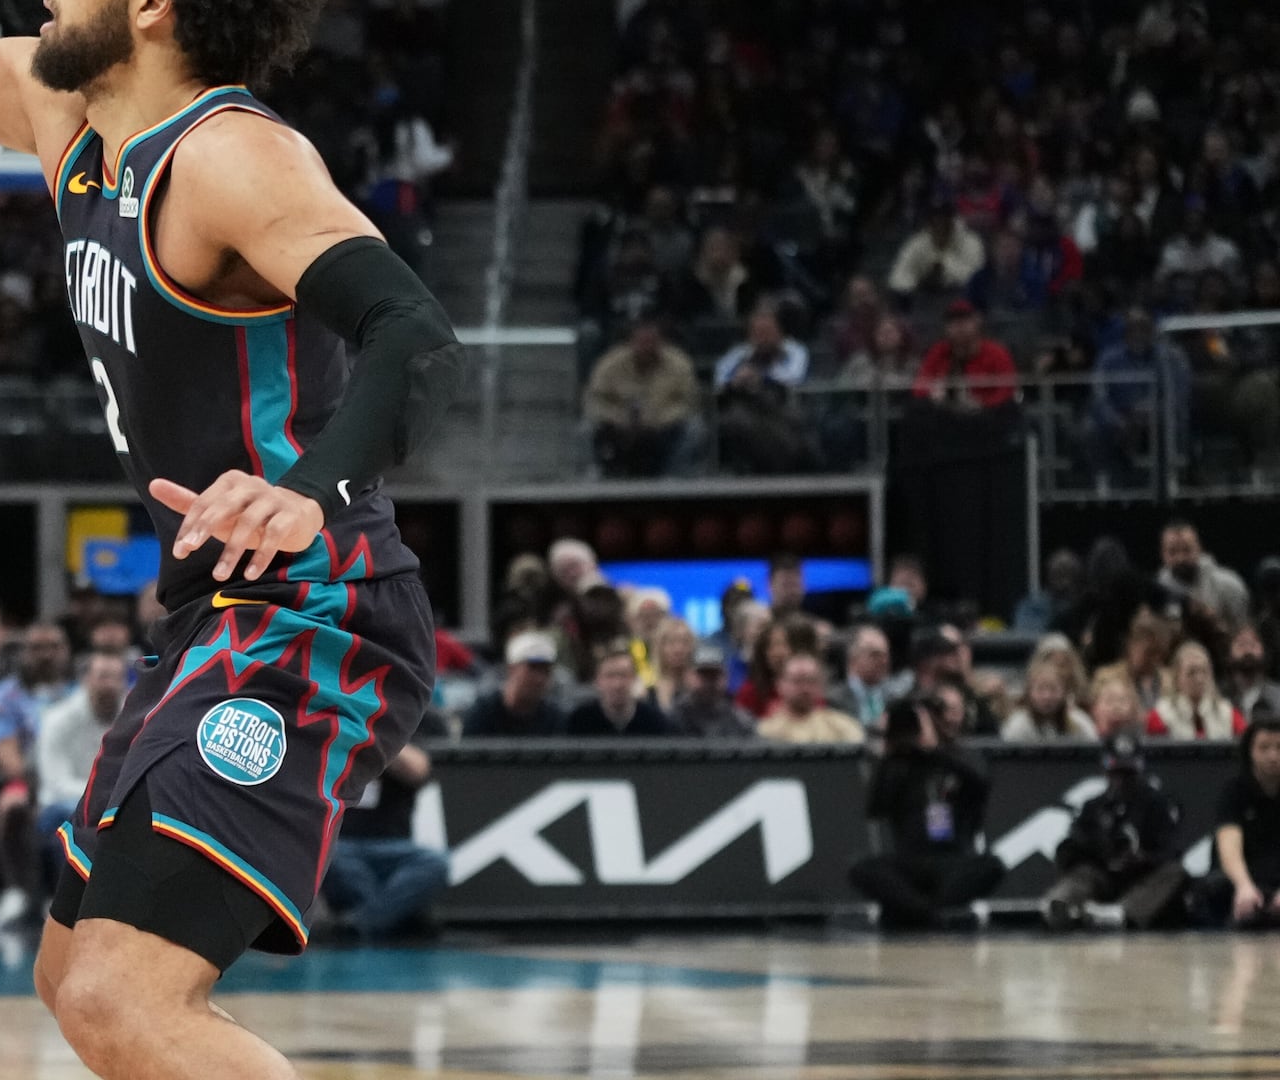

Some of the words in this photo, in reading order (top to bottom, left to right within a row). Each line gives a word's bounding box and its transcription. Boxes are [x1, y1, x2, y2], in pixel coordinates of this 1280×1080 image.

[92, 356, 130, 455] 2
[210, 723, 271, 767] PISTONS
[218, 706, 279, 748] DETROIT
[206, 740, 247, 765] BASKETBALL
[246, 760, 263, 776] CLUB
